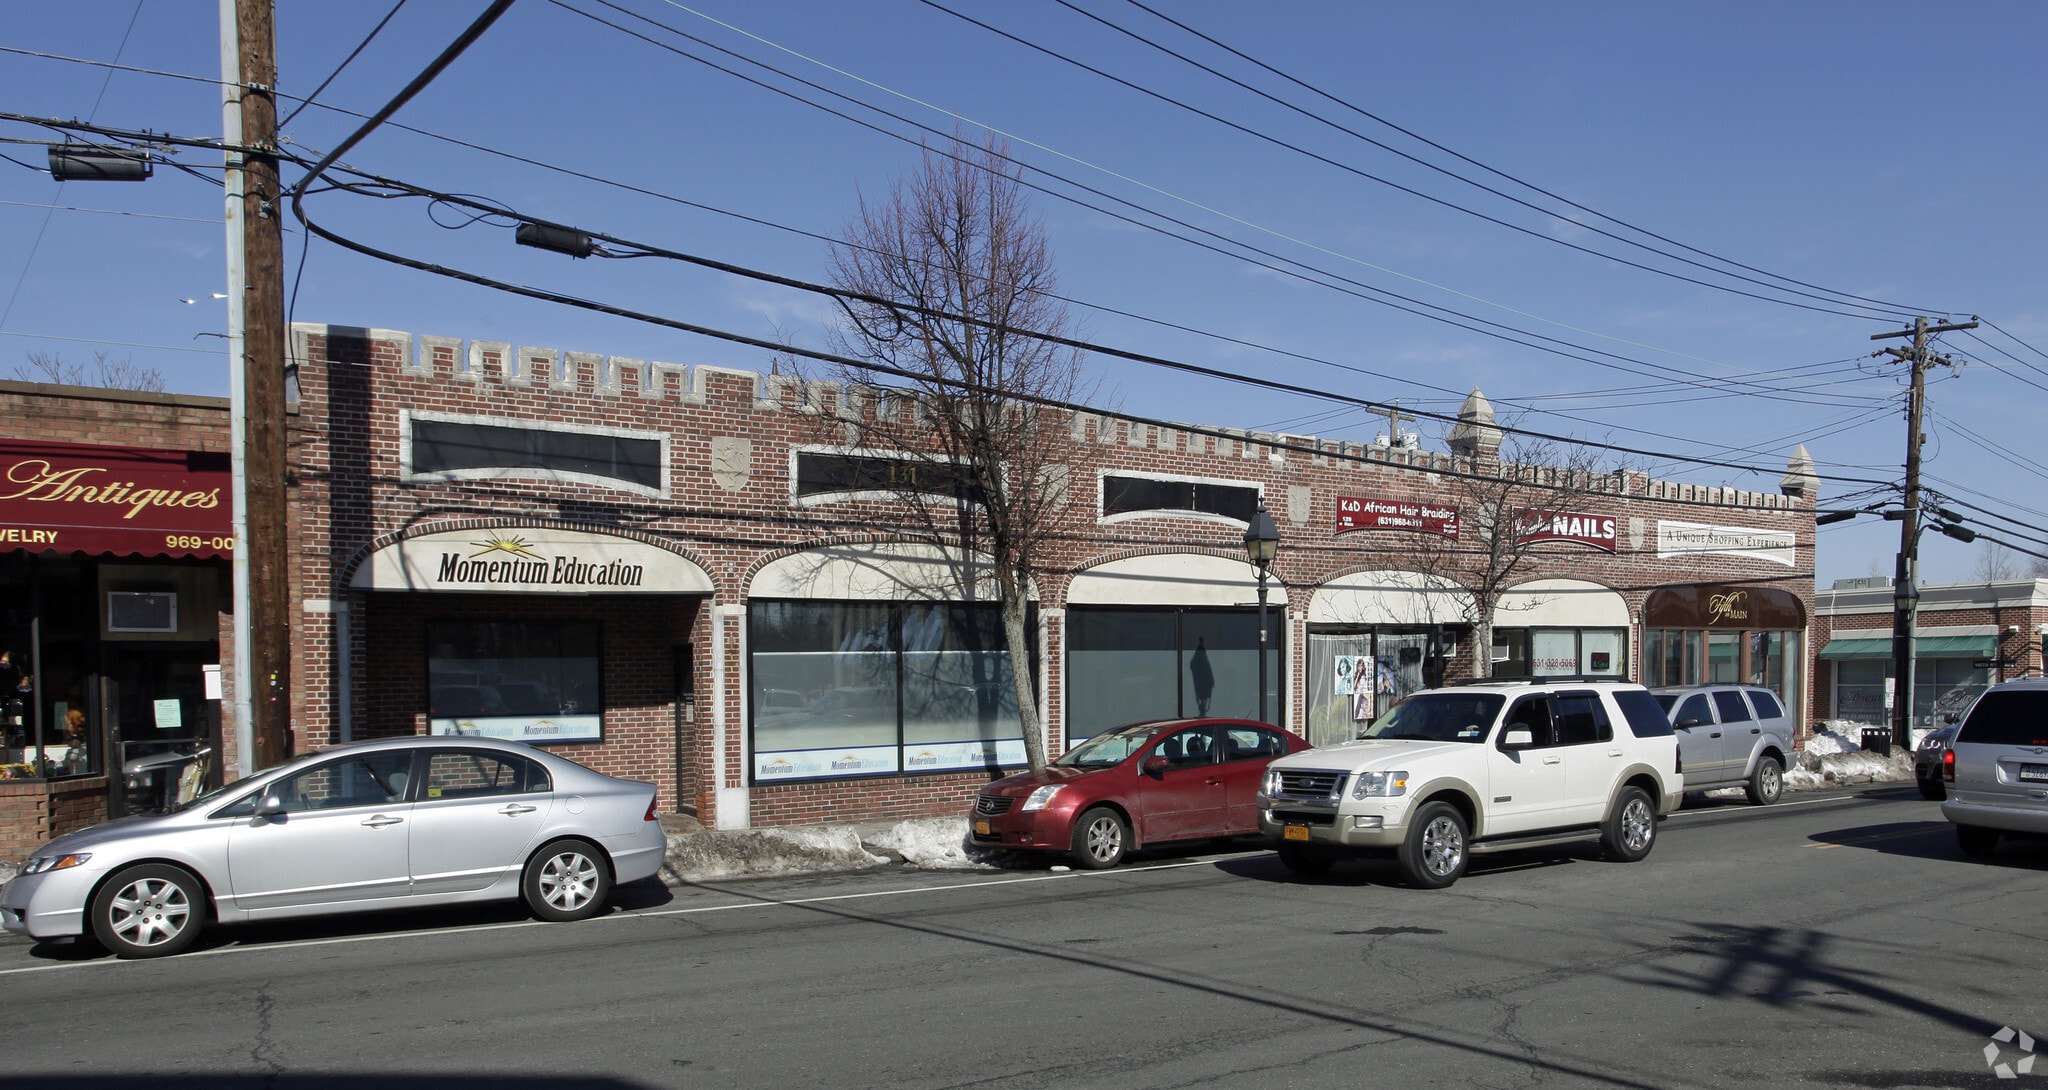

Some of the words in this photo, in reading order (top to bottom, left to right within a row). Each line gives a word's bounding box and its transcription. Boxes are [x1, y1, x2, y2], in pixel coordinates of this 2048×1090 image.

[889, 465, 918, 485] 131
[0, 459, 220, 519] Antiques
[1341, 499, 1361, 512] K&D
[1364, 501, 1397, 514] African
[1400, 504, 1419, 517] Hair
[1421, 506, 1455, 523] Braiding
[1553, 516, 1615, 539] NAILS
[1666, 530, 1673, 541] A
[437, 552, 550, 584] Momentum
[551, 556, 643, 586] Education
[523, 725, 559, 736] Momentum
[760, 764, 793, 775] Momentum
[830, 760, 861, 770] Momentum
